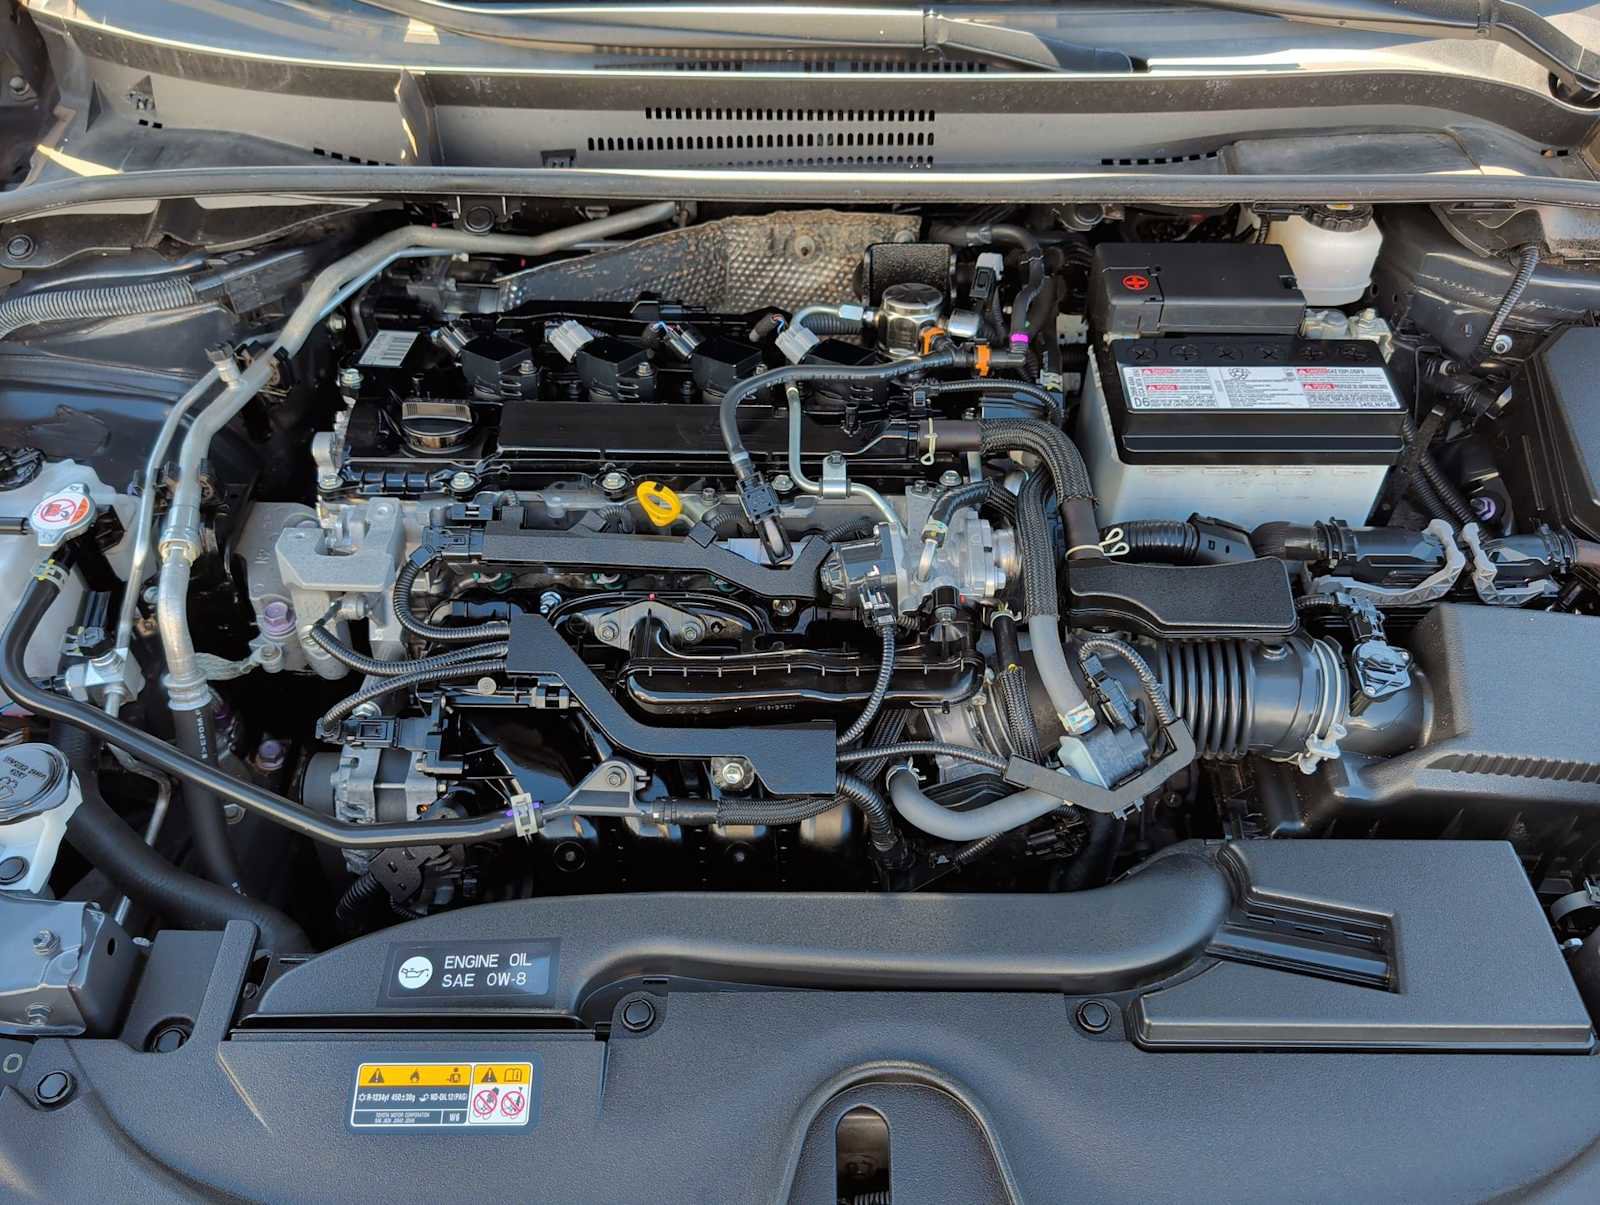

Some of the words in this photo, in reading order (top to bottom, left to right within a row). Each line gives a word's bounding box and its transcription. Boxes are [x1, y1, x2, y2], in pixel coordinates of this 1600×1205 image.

[1134, 398, 1150, 407] D6
[444, 954, 499, 969] ENGINE
[509, 953, 532, 967] OIL
[442, 973, 476, 988] SAE
[486, 971, 527, 986] 0W-8
